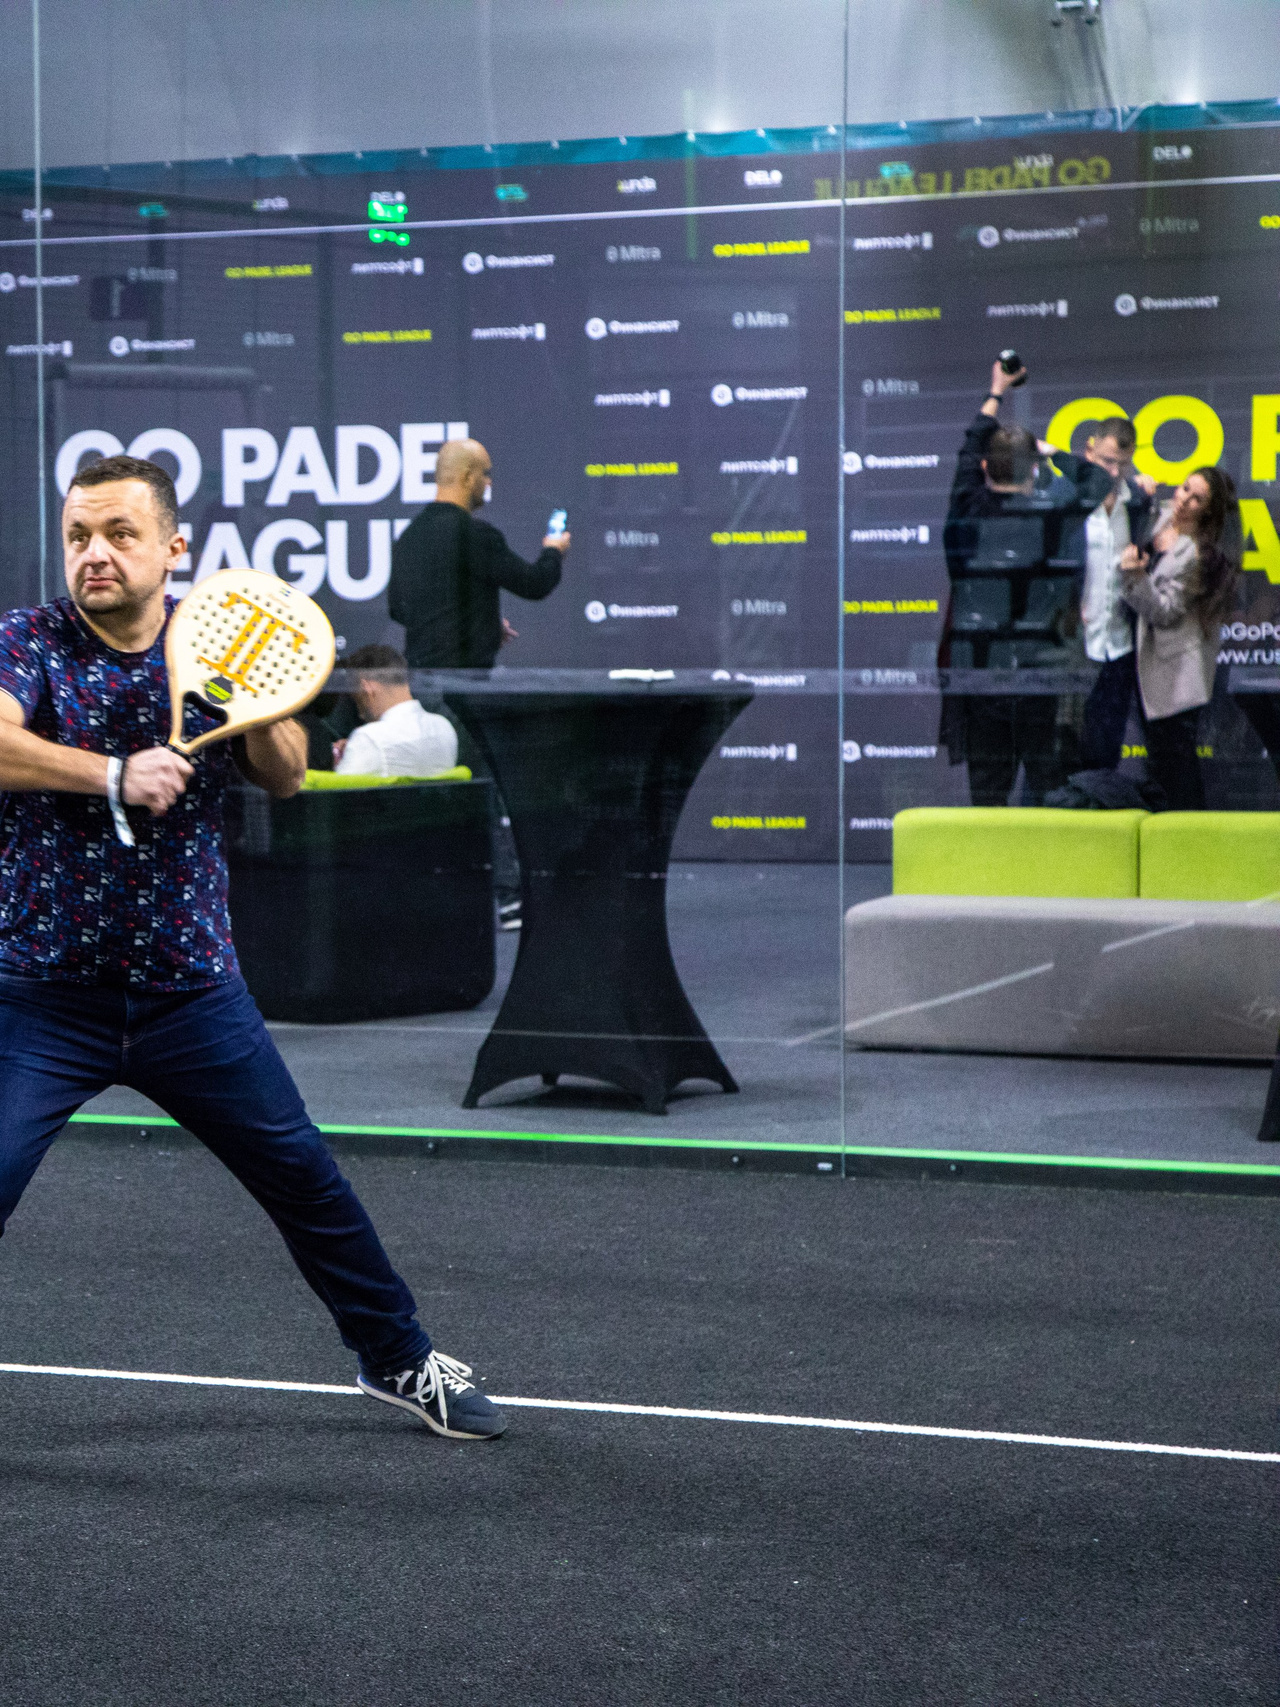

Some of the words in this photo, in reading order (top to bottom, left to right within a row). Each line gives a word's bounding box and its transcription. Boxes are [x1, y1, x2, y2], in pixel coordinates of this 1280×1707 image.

[714, 243, 733, 257] GO
[225, 267, 242, 279] GO
[845, 310, 862, 324] GO
[343, 331, 360, 344] GO
[222, 421, 492, 507] PADE
[586, 463, 604, 477] GO
[712, 531, 731, 545] GO
[166, 518, 412, 600] EAGU
[712, 816, 731, 829] GO
